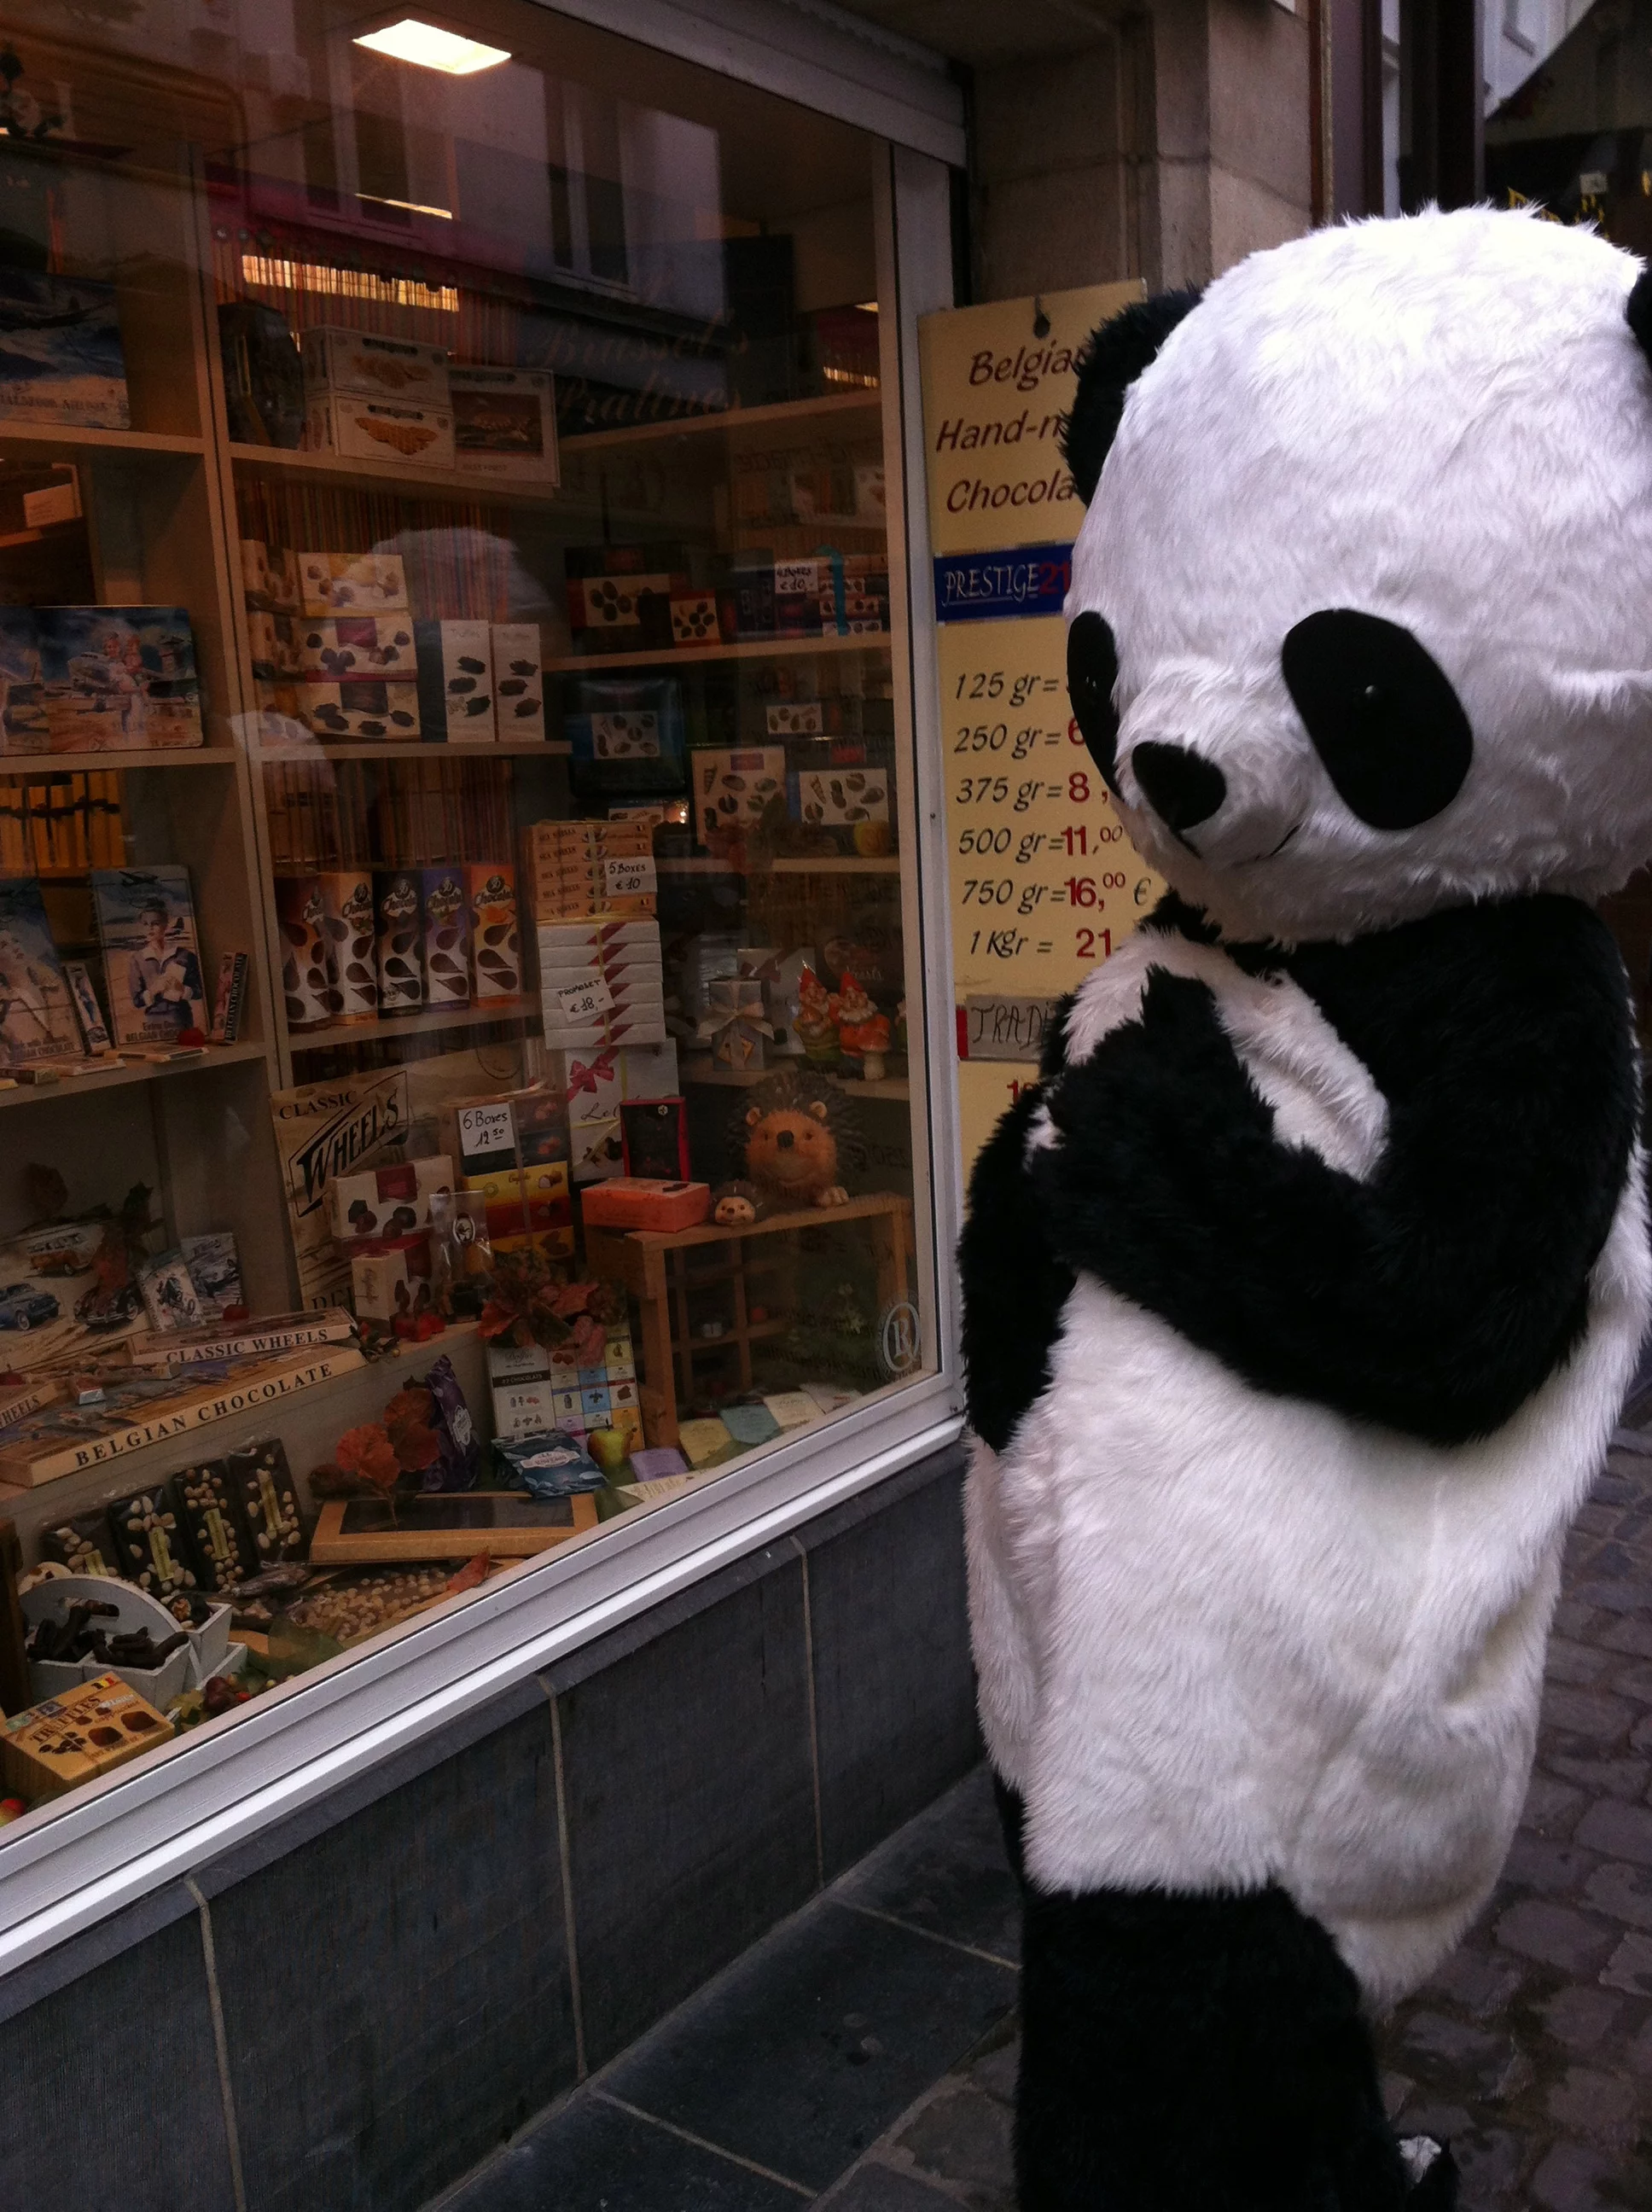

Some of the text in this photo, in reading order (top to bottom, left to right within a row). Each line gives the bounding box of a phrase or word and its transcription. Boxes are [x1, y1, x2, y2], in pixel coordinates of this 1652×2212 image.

[941, 563, 1038, 607] PRESTIGE
[956, 671, 1004, 700] 125
[954, 723, 1008, 754] 250
[956, 776, 1009, 804] 375
[958, 828, 1011, 855] 500
[609, 862, 616, 875] 5
[625, 878, 641, 890] 10
[962, 879, 1014, 905] 750
[1075, 928, 1111, 958] 21
[279, 1091, 357, 1120] CLASSIC
[463, 1110, 509, 1130] 6 Boxes
[296, 1086, 398, 1203] WHEELS
[166, 1342, 246, 1365] CLASSIC
[253, 1329, 329, 1355] WHEELS
[75, 1363, 332, 1467] BELGIAN CHOCOLATE
